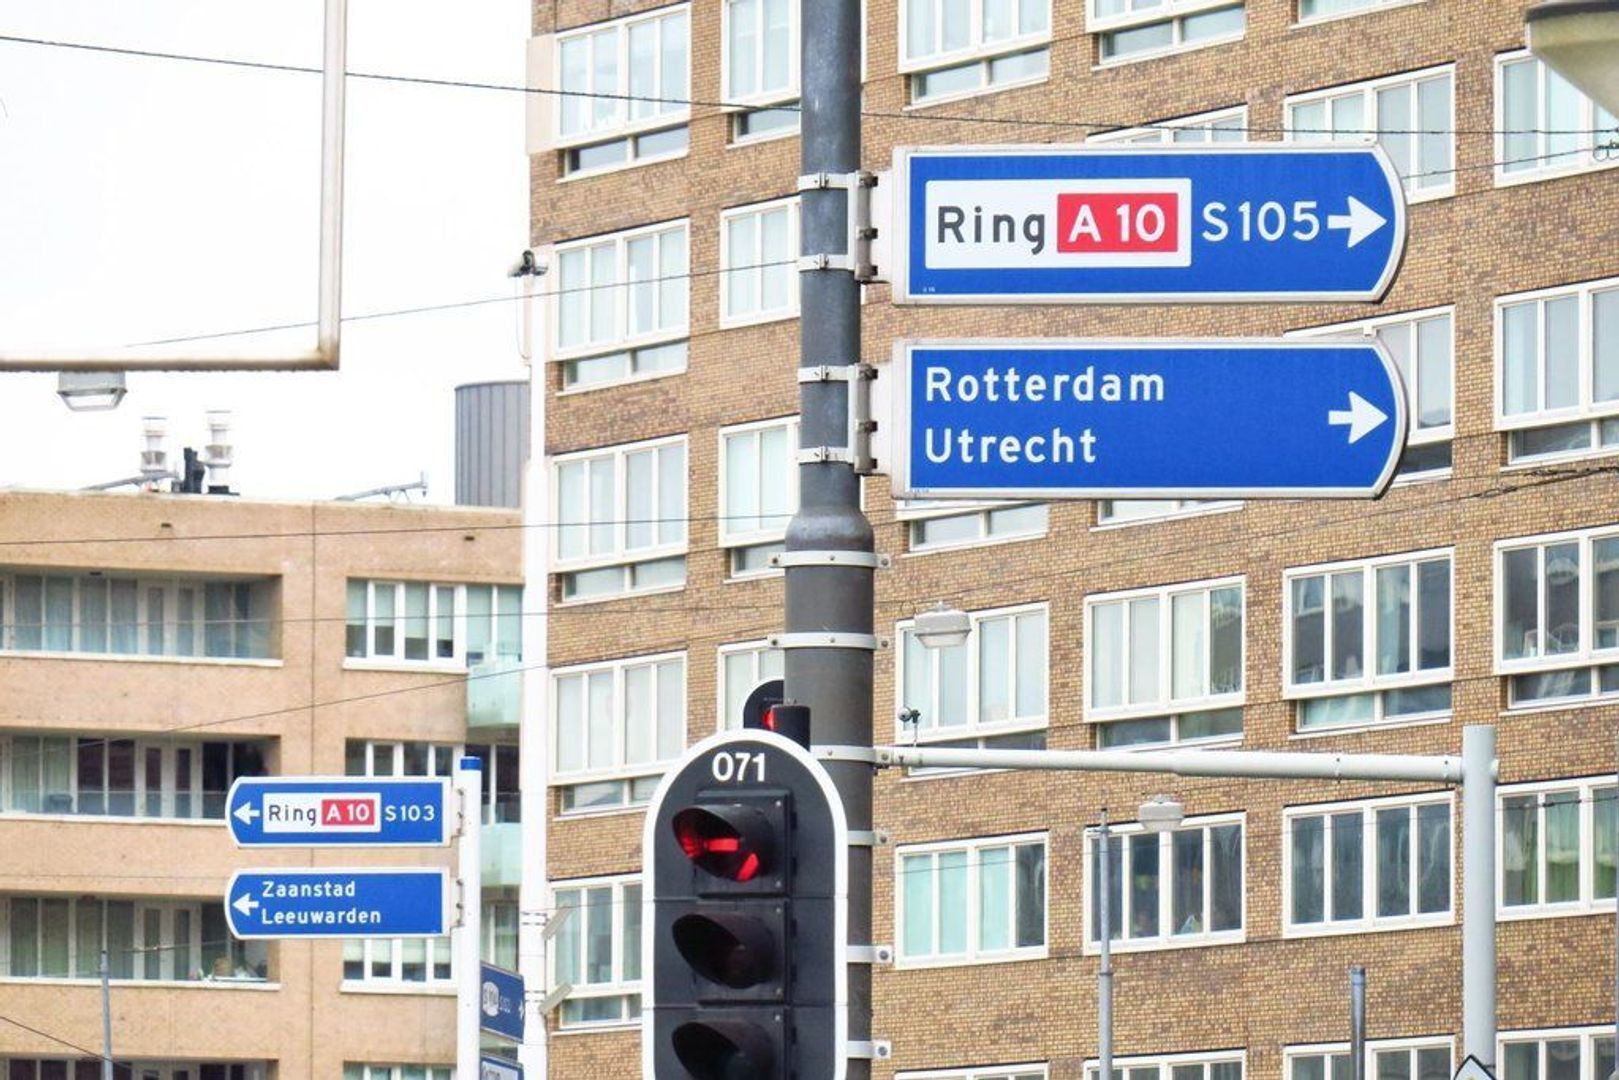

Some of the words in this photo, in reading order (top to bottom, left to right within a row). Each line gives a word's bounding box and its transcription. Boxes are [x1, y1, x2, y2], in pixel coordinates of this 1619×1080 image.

[937, 205, 1045, 256] Ring
[1201, 200, 1320, 242] S105
[926, 365, 1165, 402] Rotterdam
[925, 427, 1097, 464] Utrecht
[711, 751, 766, 783] 071
[268, 804, 317, 827] Ring
[384, 804, 435, 822] S103
[261, 880, 356, 898] Zaanstad
[260, 907, 382, 925] Leeuwarden
